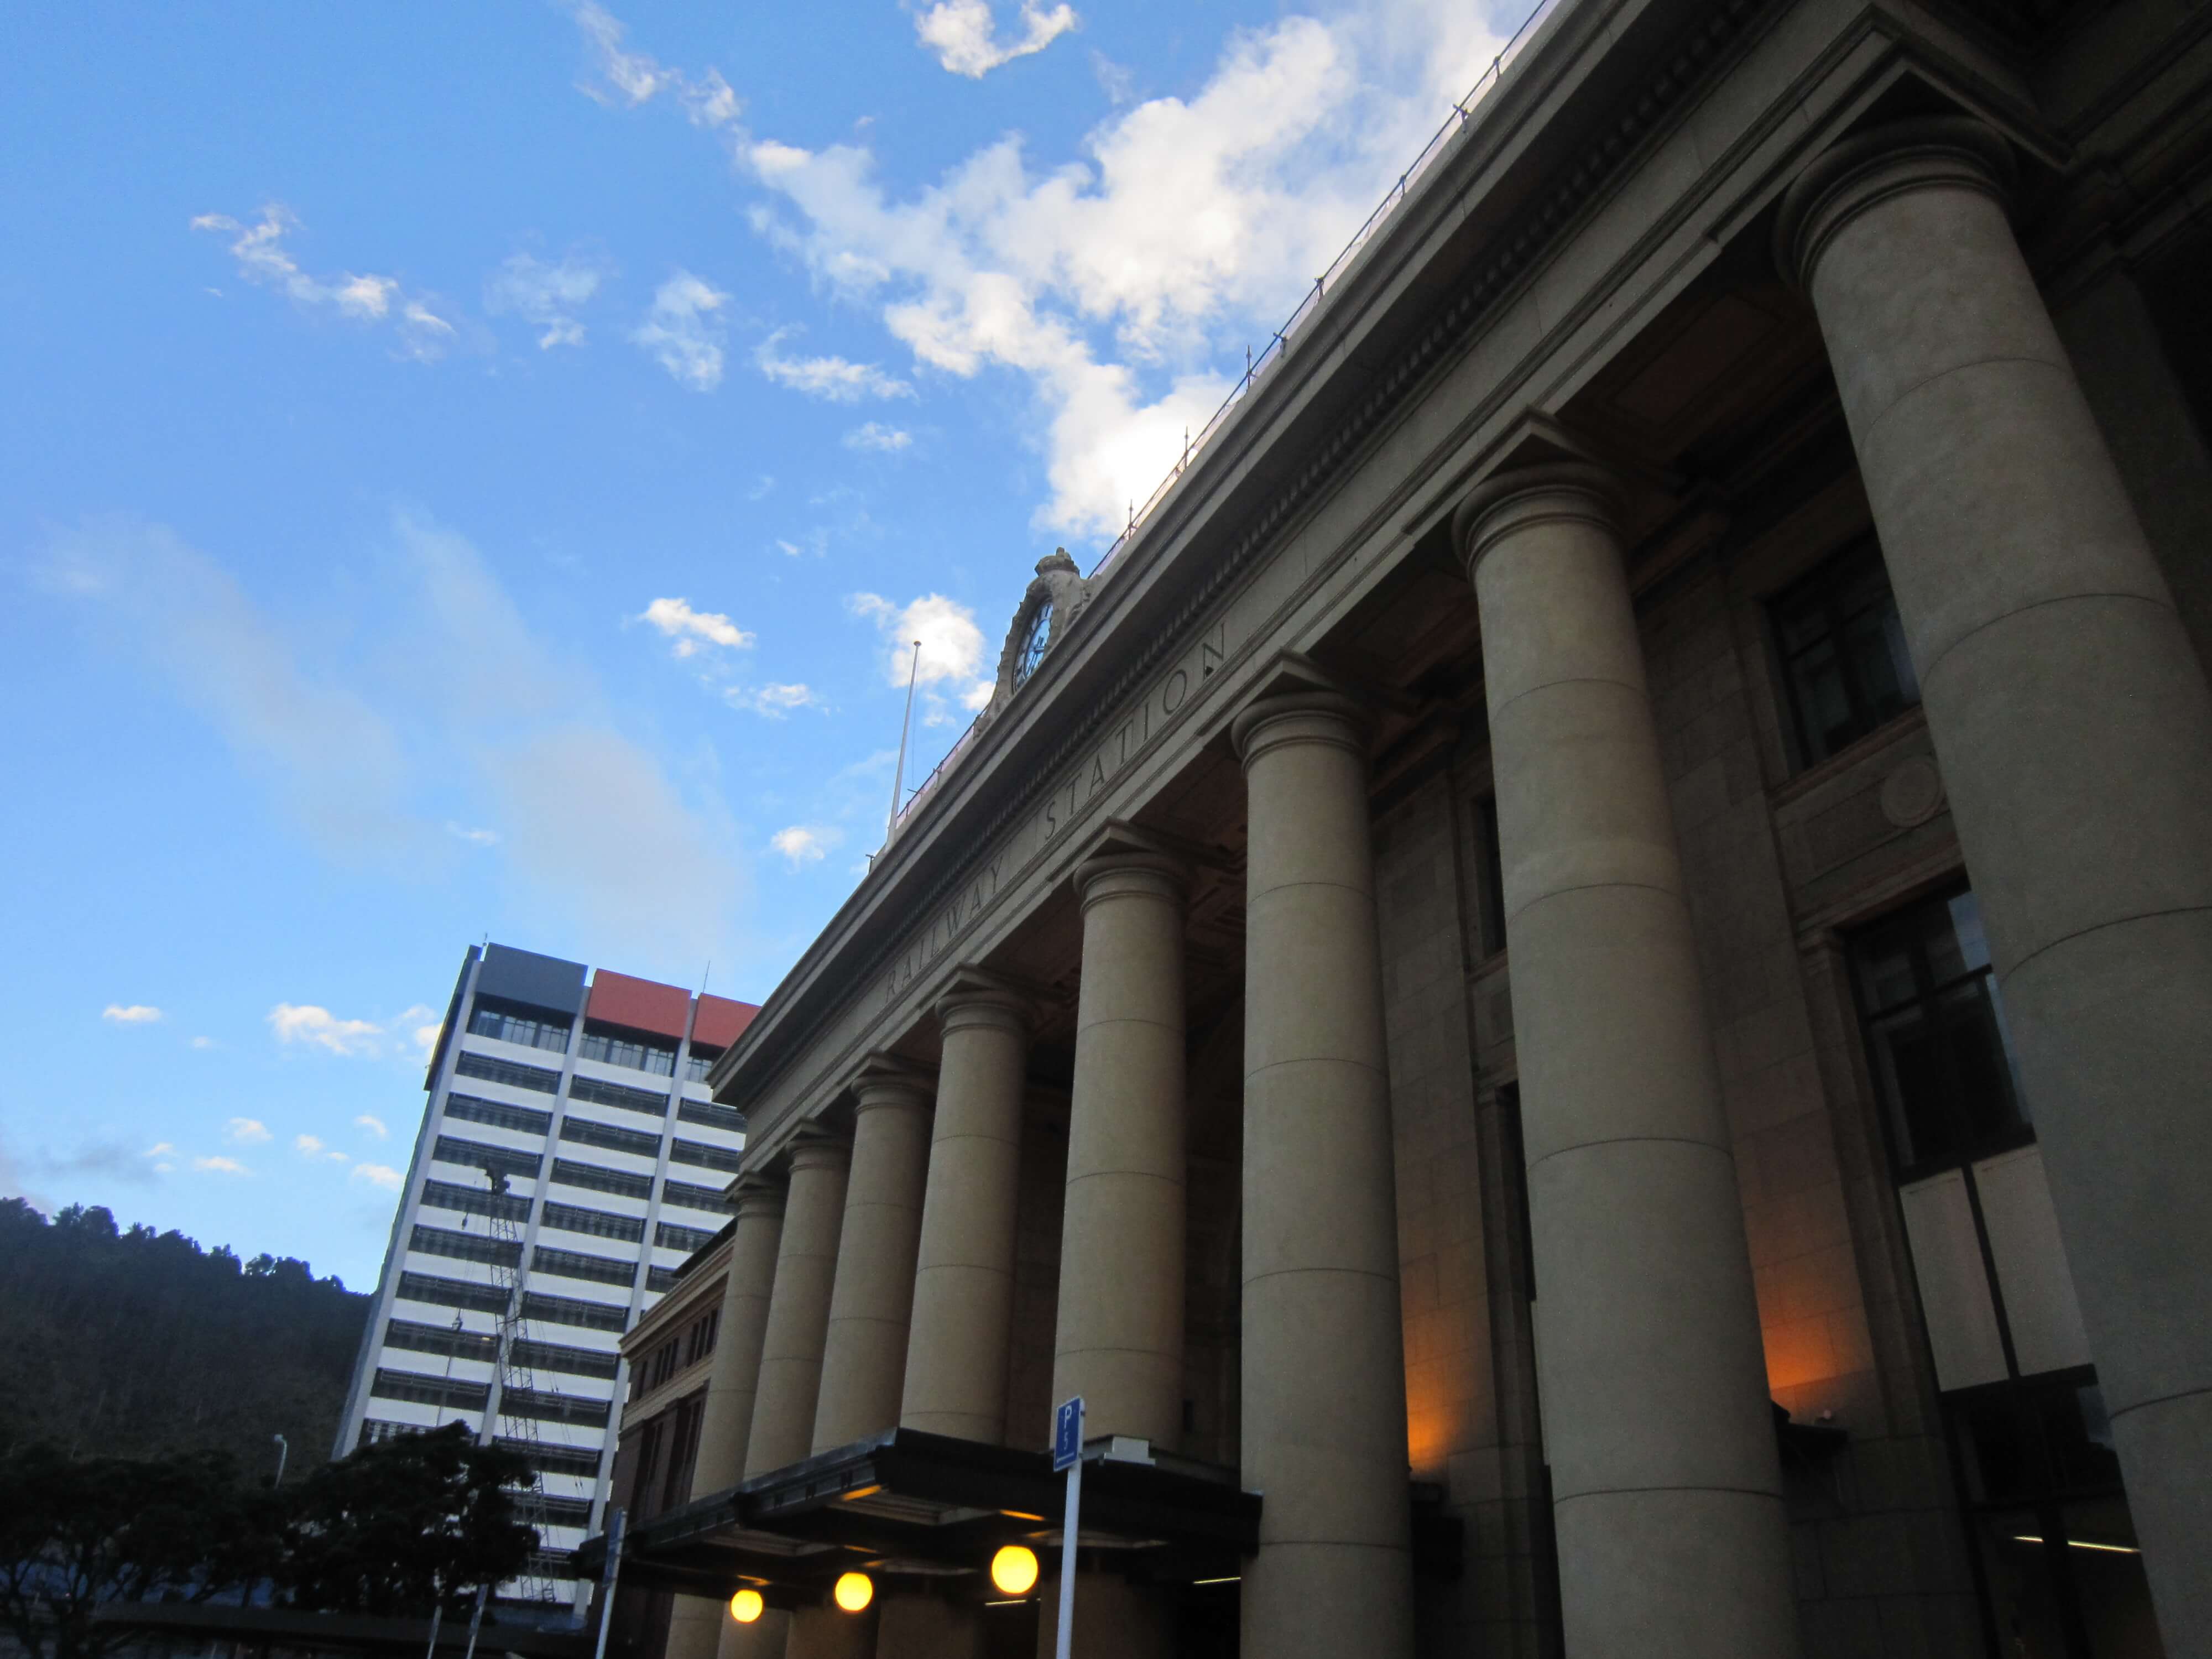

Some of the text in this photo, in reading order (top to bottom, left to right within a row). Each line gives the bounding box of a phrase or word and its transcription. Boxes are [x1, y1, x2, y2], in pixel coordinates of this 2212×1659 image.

[886, 622, 1225, 1002] RAILWAY STATION
[1064, 1405, 1072, 1429] P
